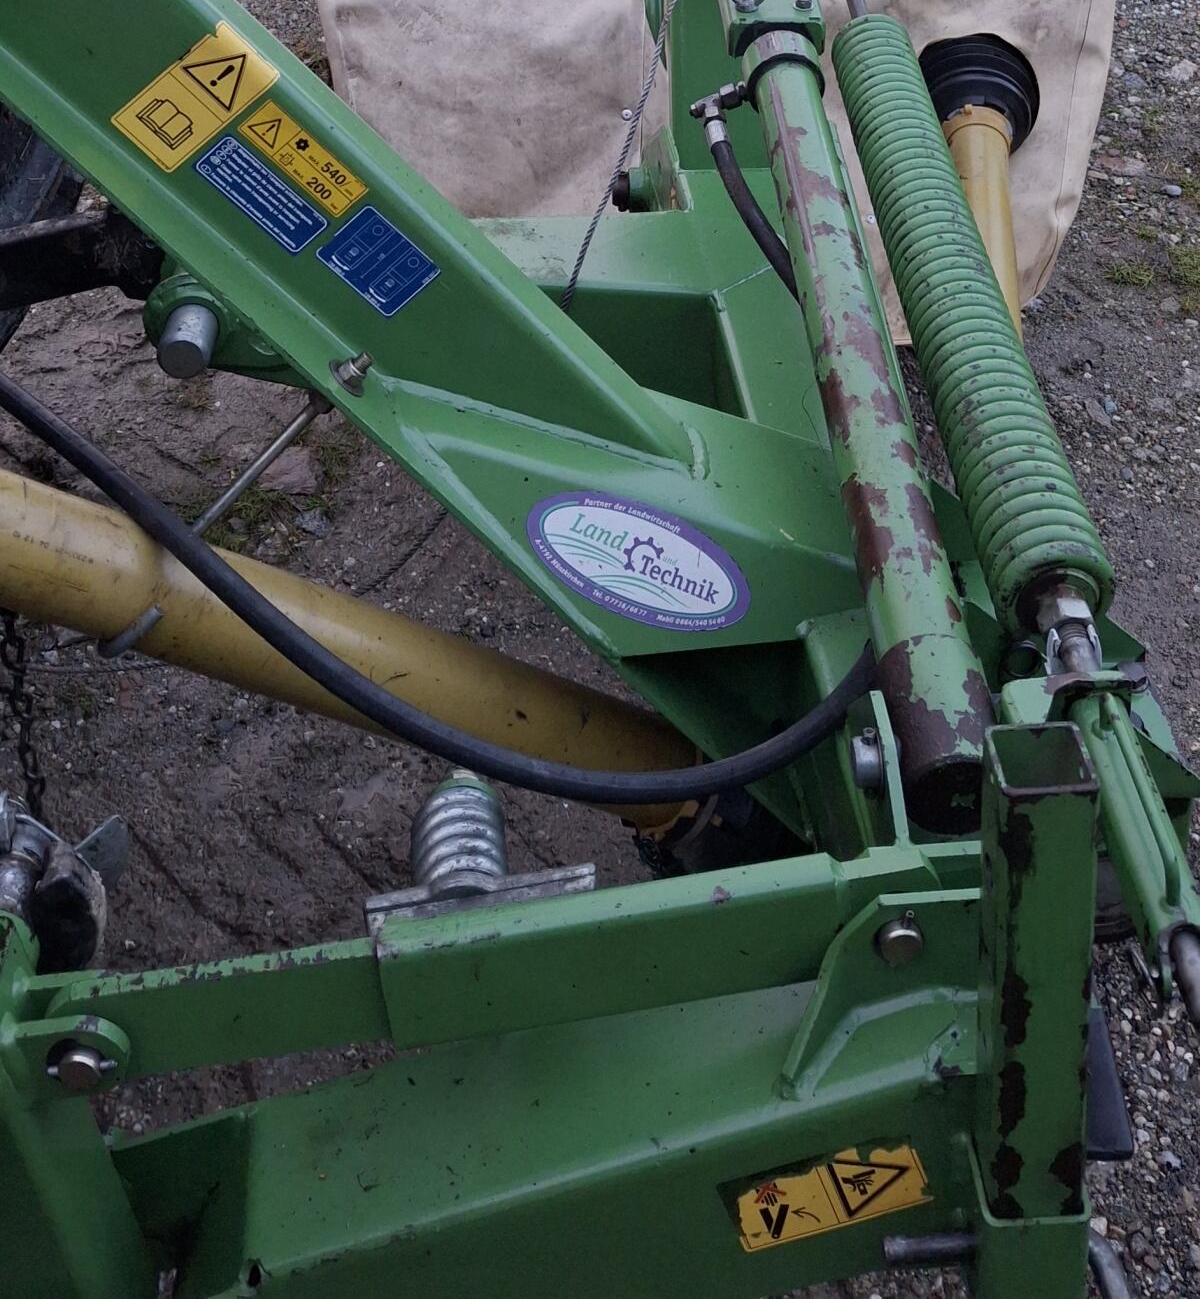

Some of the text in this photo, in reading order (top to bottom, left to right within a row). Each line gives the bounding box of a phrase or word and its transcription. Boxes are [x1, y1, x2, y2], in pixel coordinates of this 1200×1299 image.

[306, 176, 332, 200] 200
[569, 513, 628, 551] Land
[584, 498, 681, 533] Partner der Landwirtschaft
[662, 556, 678, 566] und
[639, 554, 719, 604] Technik
